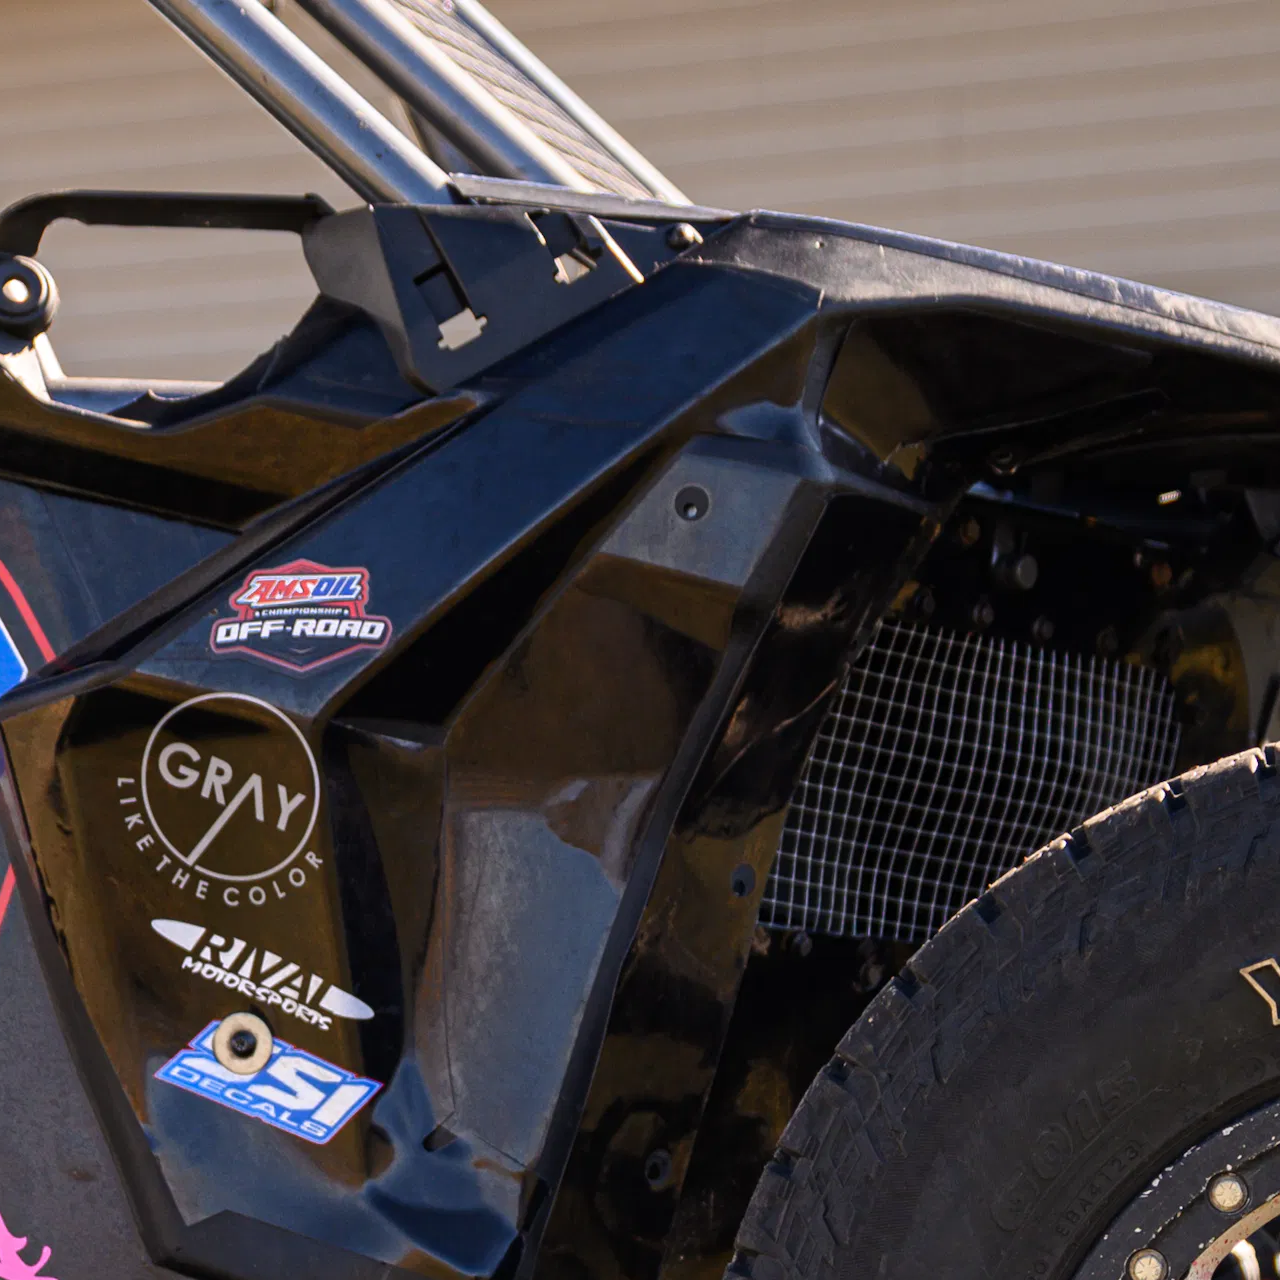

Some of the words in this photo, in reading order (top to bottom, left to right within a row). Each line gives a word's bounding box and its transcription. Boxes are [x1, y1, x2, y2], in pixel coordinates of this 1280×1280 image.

[240, 575, 363, 604] AMSOIL
[261, 607, 344, 617] CHAMPIONSHIP
[215, 618, 386, 643] OFF-ROAD
[158, 742, 307, 862] GRAY
[181, 955, 333, 1031] MOTORSPORTS
[195, 932, 332, 1010] RIVAL
[170, 1066, 328, 1138] DECALS
